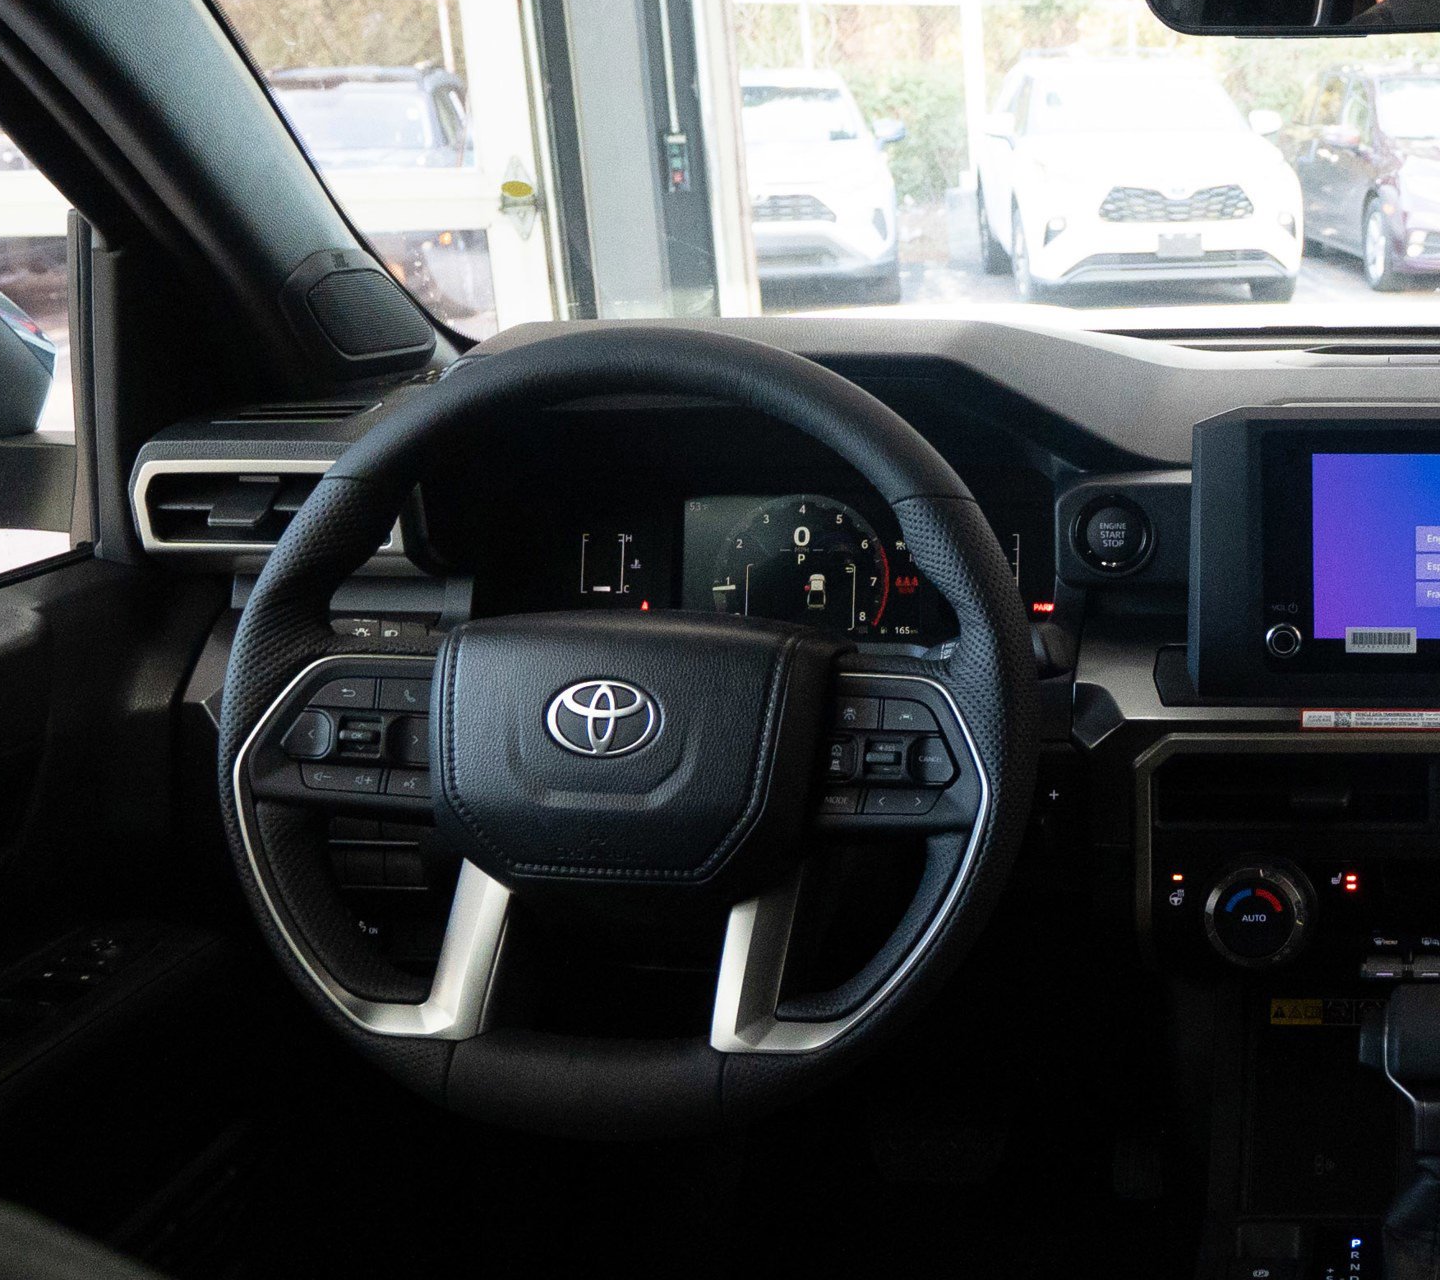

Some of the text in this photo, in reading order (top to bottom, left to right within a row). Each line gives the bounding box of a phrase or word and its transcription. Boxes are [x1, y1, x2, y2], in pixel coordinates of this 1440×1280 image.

[799, 504, 806, 515] 4
[763, 515, 770, 524] 3
[836, 515, 843, 524] 5
[1100, 522, 1127, 530] ENGINE
[625, 534, 633, 543] H
[794, 526, 810, 547] 0
[1100, 531, 1125, 539] START
[736, 539, 743, 549] 2
[861, 540, 868, 549] 6
[1102, 540, 1125, 548] STOP
[797, 554, 806, 565] P
[870, 577, 878, 587] 7
[859, 611, 867, 622] 8
[895, 626, 910, 635] 165
[824, 796, 849, 805] MODE
[1241, 914, 1267, 923] AUTO
[1351, 1239, 1361, 1248] P
[1350, 1251, 1360, 1259] R
[1350, 1263, 1360, 1271] N
